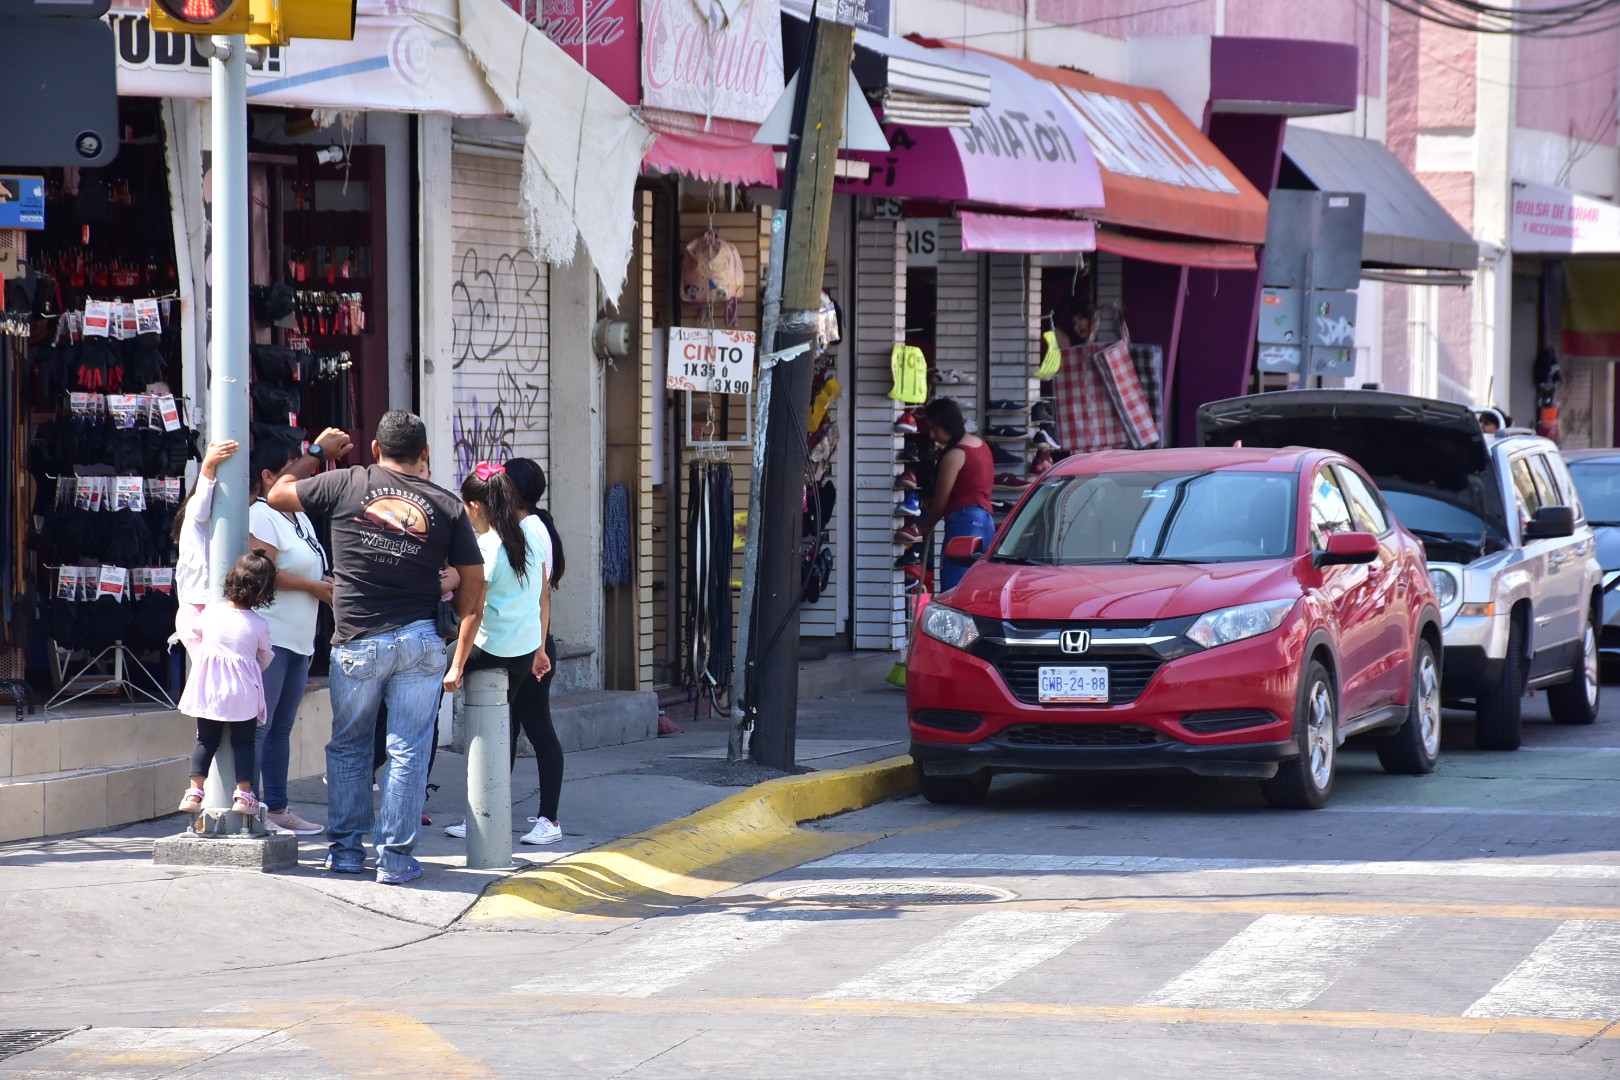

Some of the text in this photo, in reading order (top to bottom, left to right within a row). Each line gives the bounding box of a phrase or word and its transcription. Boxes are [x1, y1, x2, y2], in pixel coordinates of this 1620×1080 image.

[838, 0, 855, 19] San
[854, 5, 869, 23] Luis
[1515, 199, 1600, 223] BOLSA DE DAMA
[1522, 221, 1529, 233] Y
[683, 343, 743, 364] CINTO
[370, 487, 434, 515] ESTABLISHED
[359, 530, 422, 557] Wrangler
[1042, 676, 1106, 692] GWB-24-88
